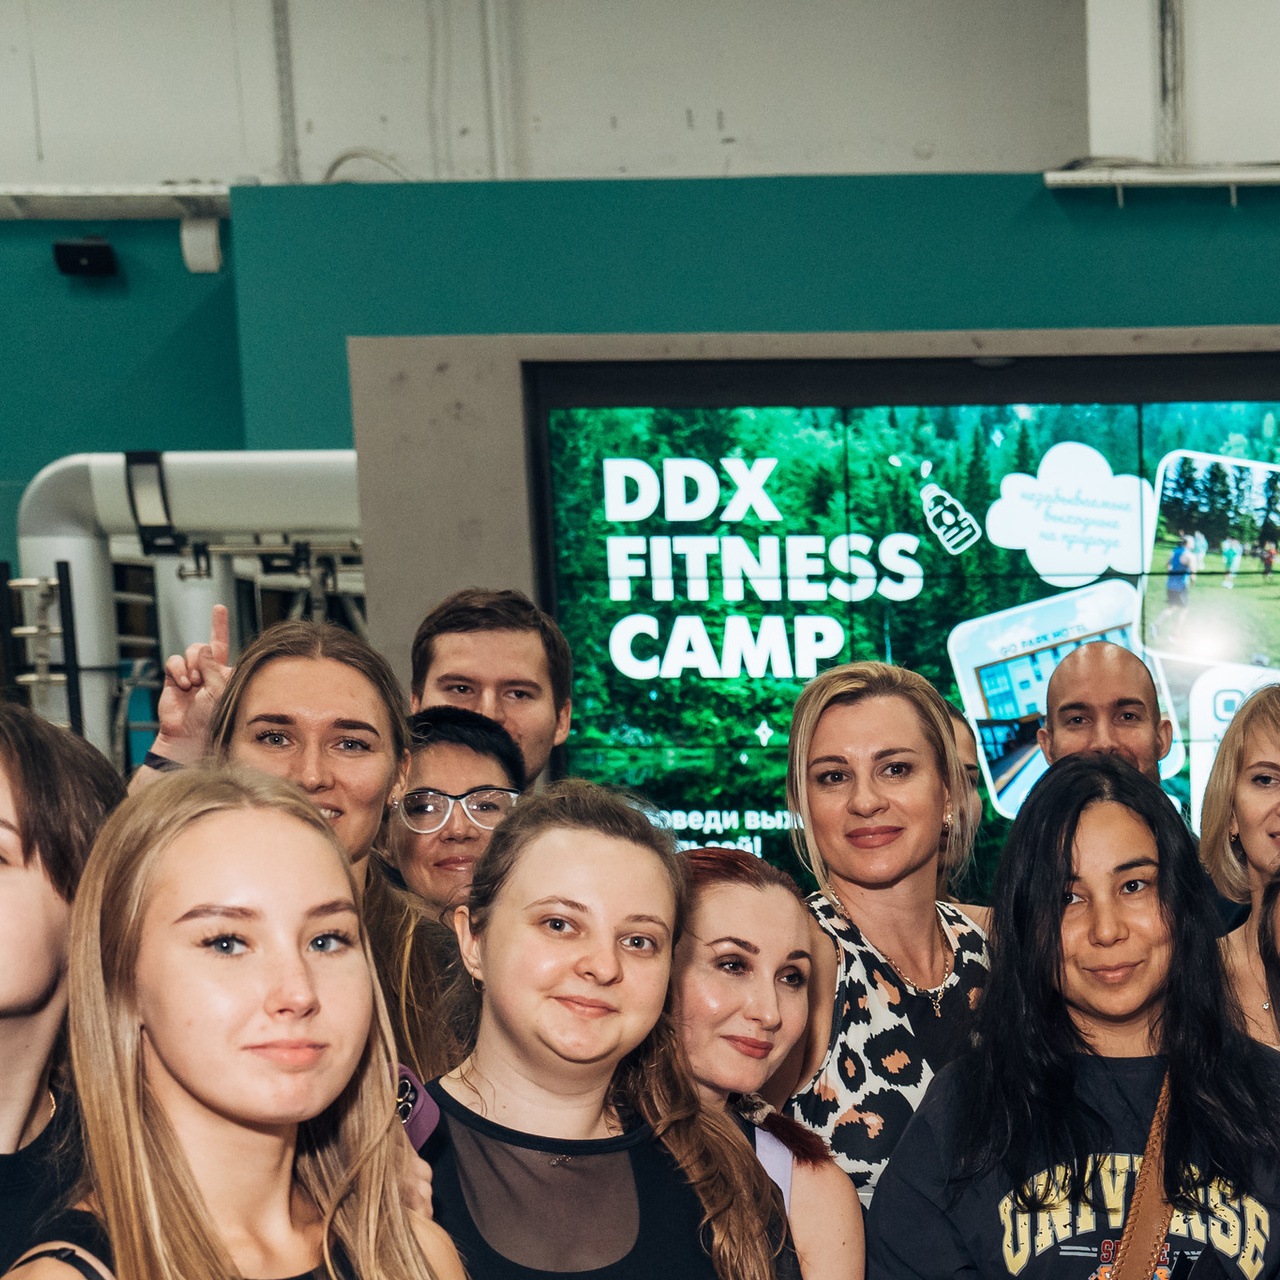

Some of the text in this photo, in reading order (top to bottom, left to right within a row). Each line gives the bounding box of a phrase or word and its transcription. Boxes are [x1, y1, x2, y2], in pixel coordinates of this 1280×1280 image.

[602, 457, 784, 522] DDX
[606, 532, 925, 602] FITNESS
[608, 613, 845, 680] CAMP
